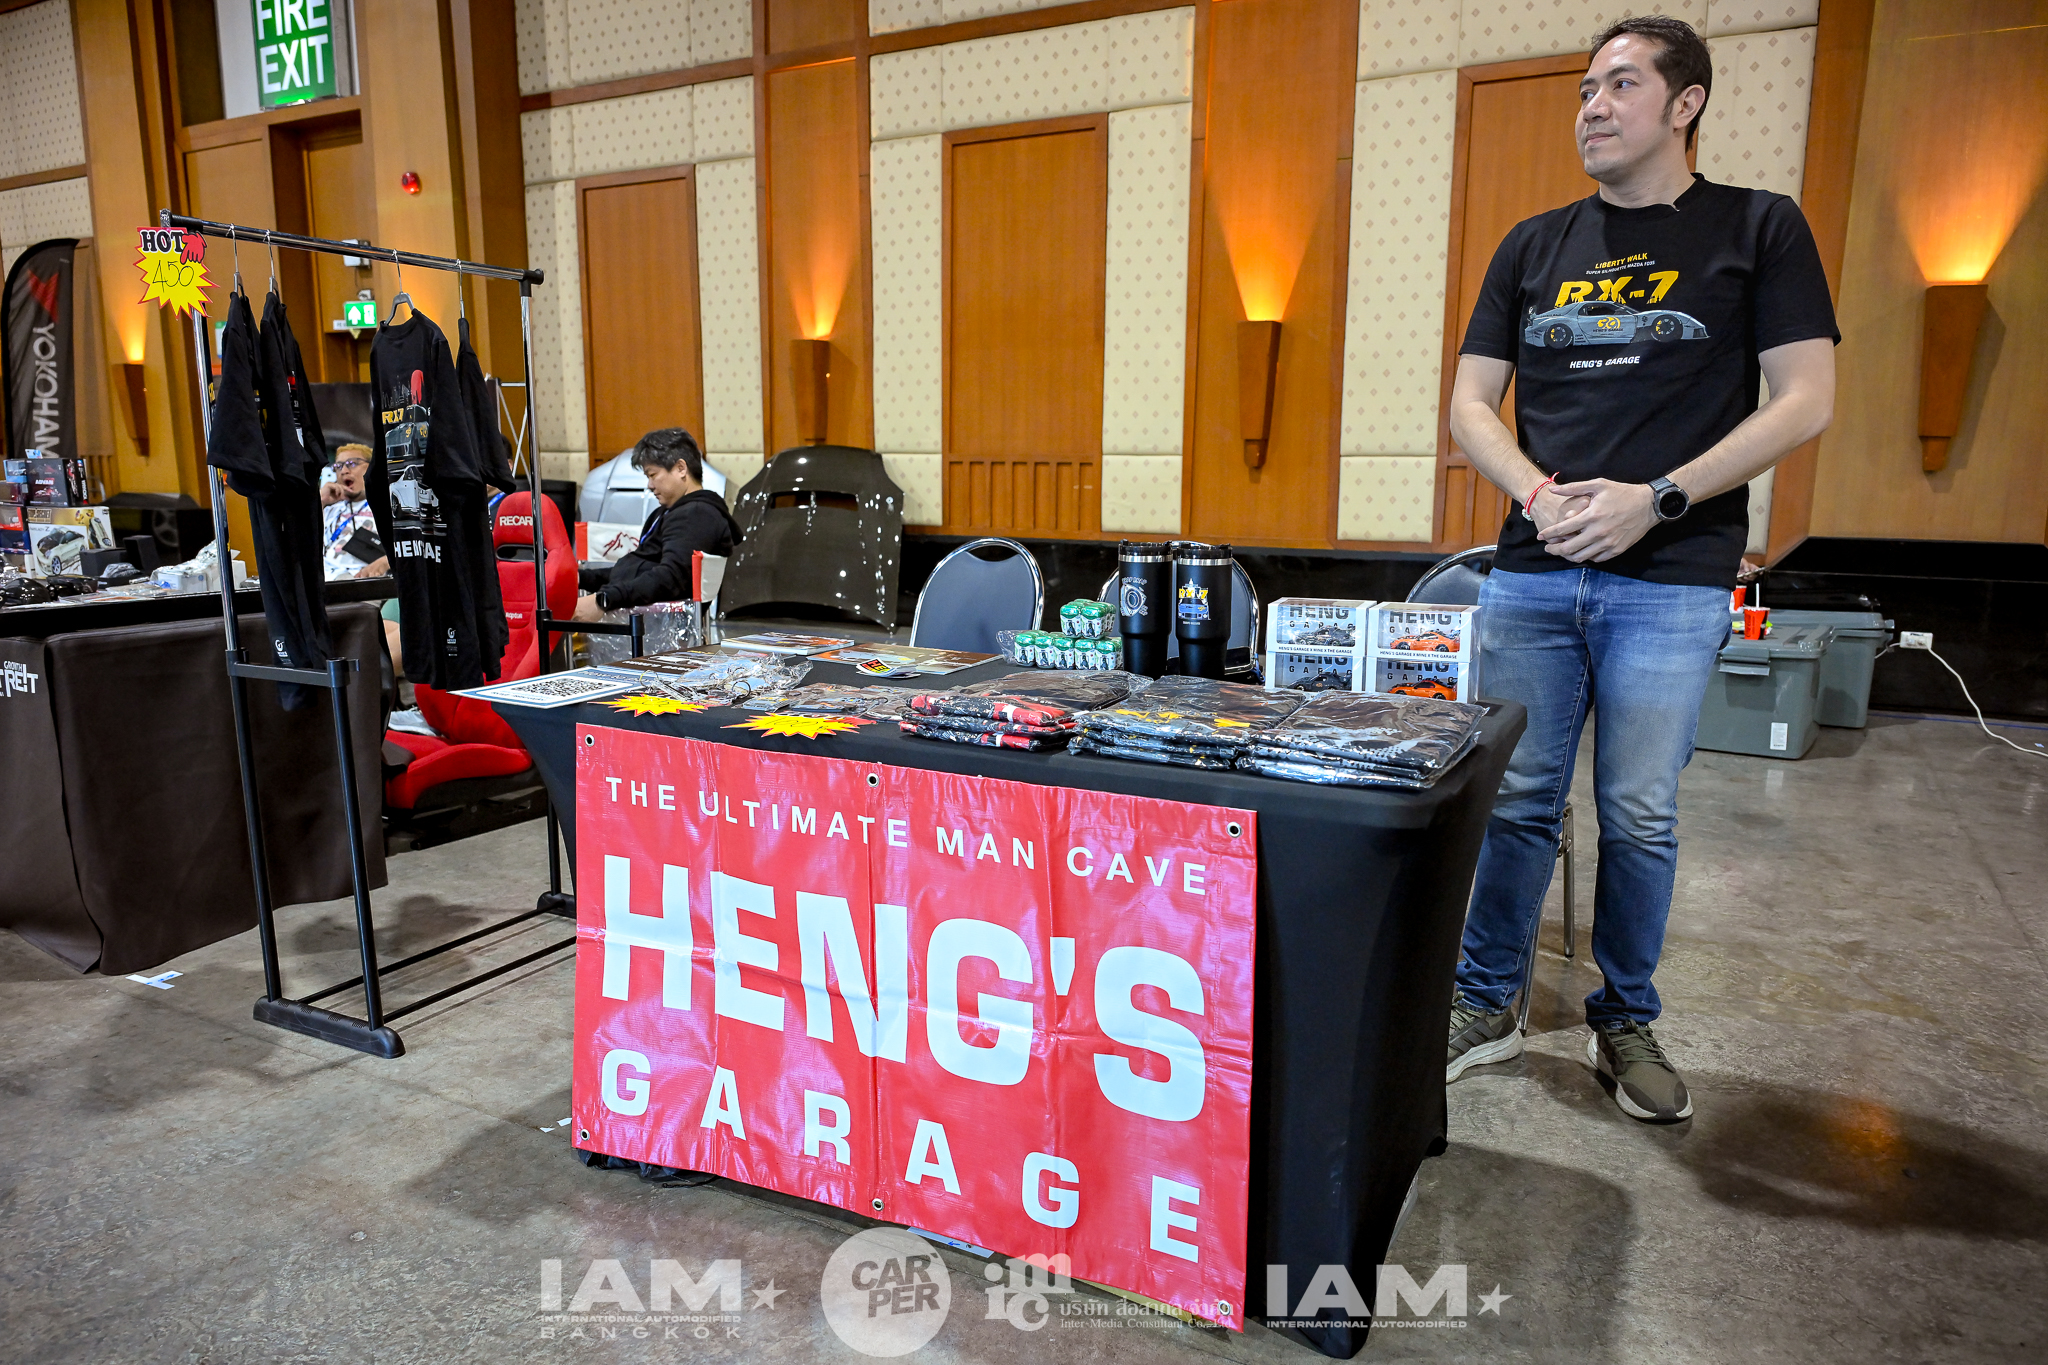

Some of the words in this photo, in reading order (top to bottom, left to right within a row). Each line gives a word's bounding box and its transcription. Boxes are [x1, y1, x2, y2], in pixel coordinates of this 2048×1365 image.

[256, 0, 328, 40] FIRE
[260, 33, 329, 94] EXIT
[140, 230, 185, 254] HOT
[1595, 257, 1626, 269] LIBERTY
[1627, 252, 1648, 263] WALK
[152, 260, 194, 293] 450
[1554, 271, 1679, 309] RX-7
[1569, 359, 1603, 369] HENG'S
[1604, 355, 1641, 366] GARAGE
[32, 322, 60, 459] YOKOHAM
[500, 515, 533, 526] RECAR
[1389, 611, 1461, 625] HENG
[604, 776, 677, 811] THE
[698, 790, 909, 849] ULTIMATE
[936, 826, 1036, 870] MAN
[1066, 846, 1207, 896] CAVE
[602, 854, 1206, 1122] HENG'S
[601, 1049, 1200, 1263] GARAGE
